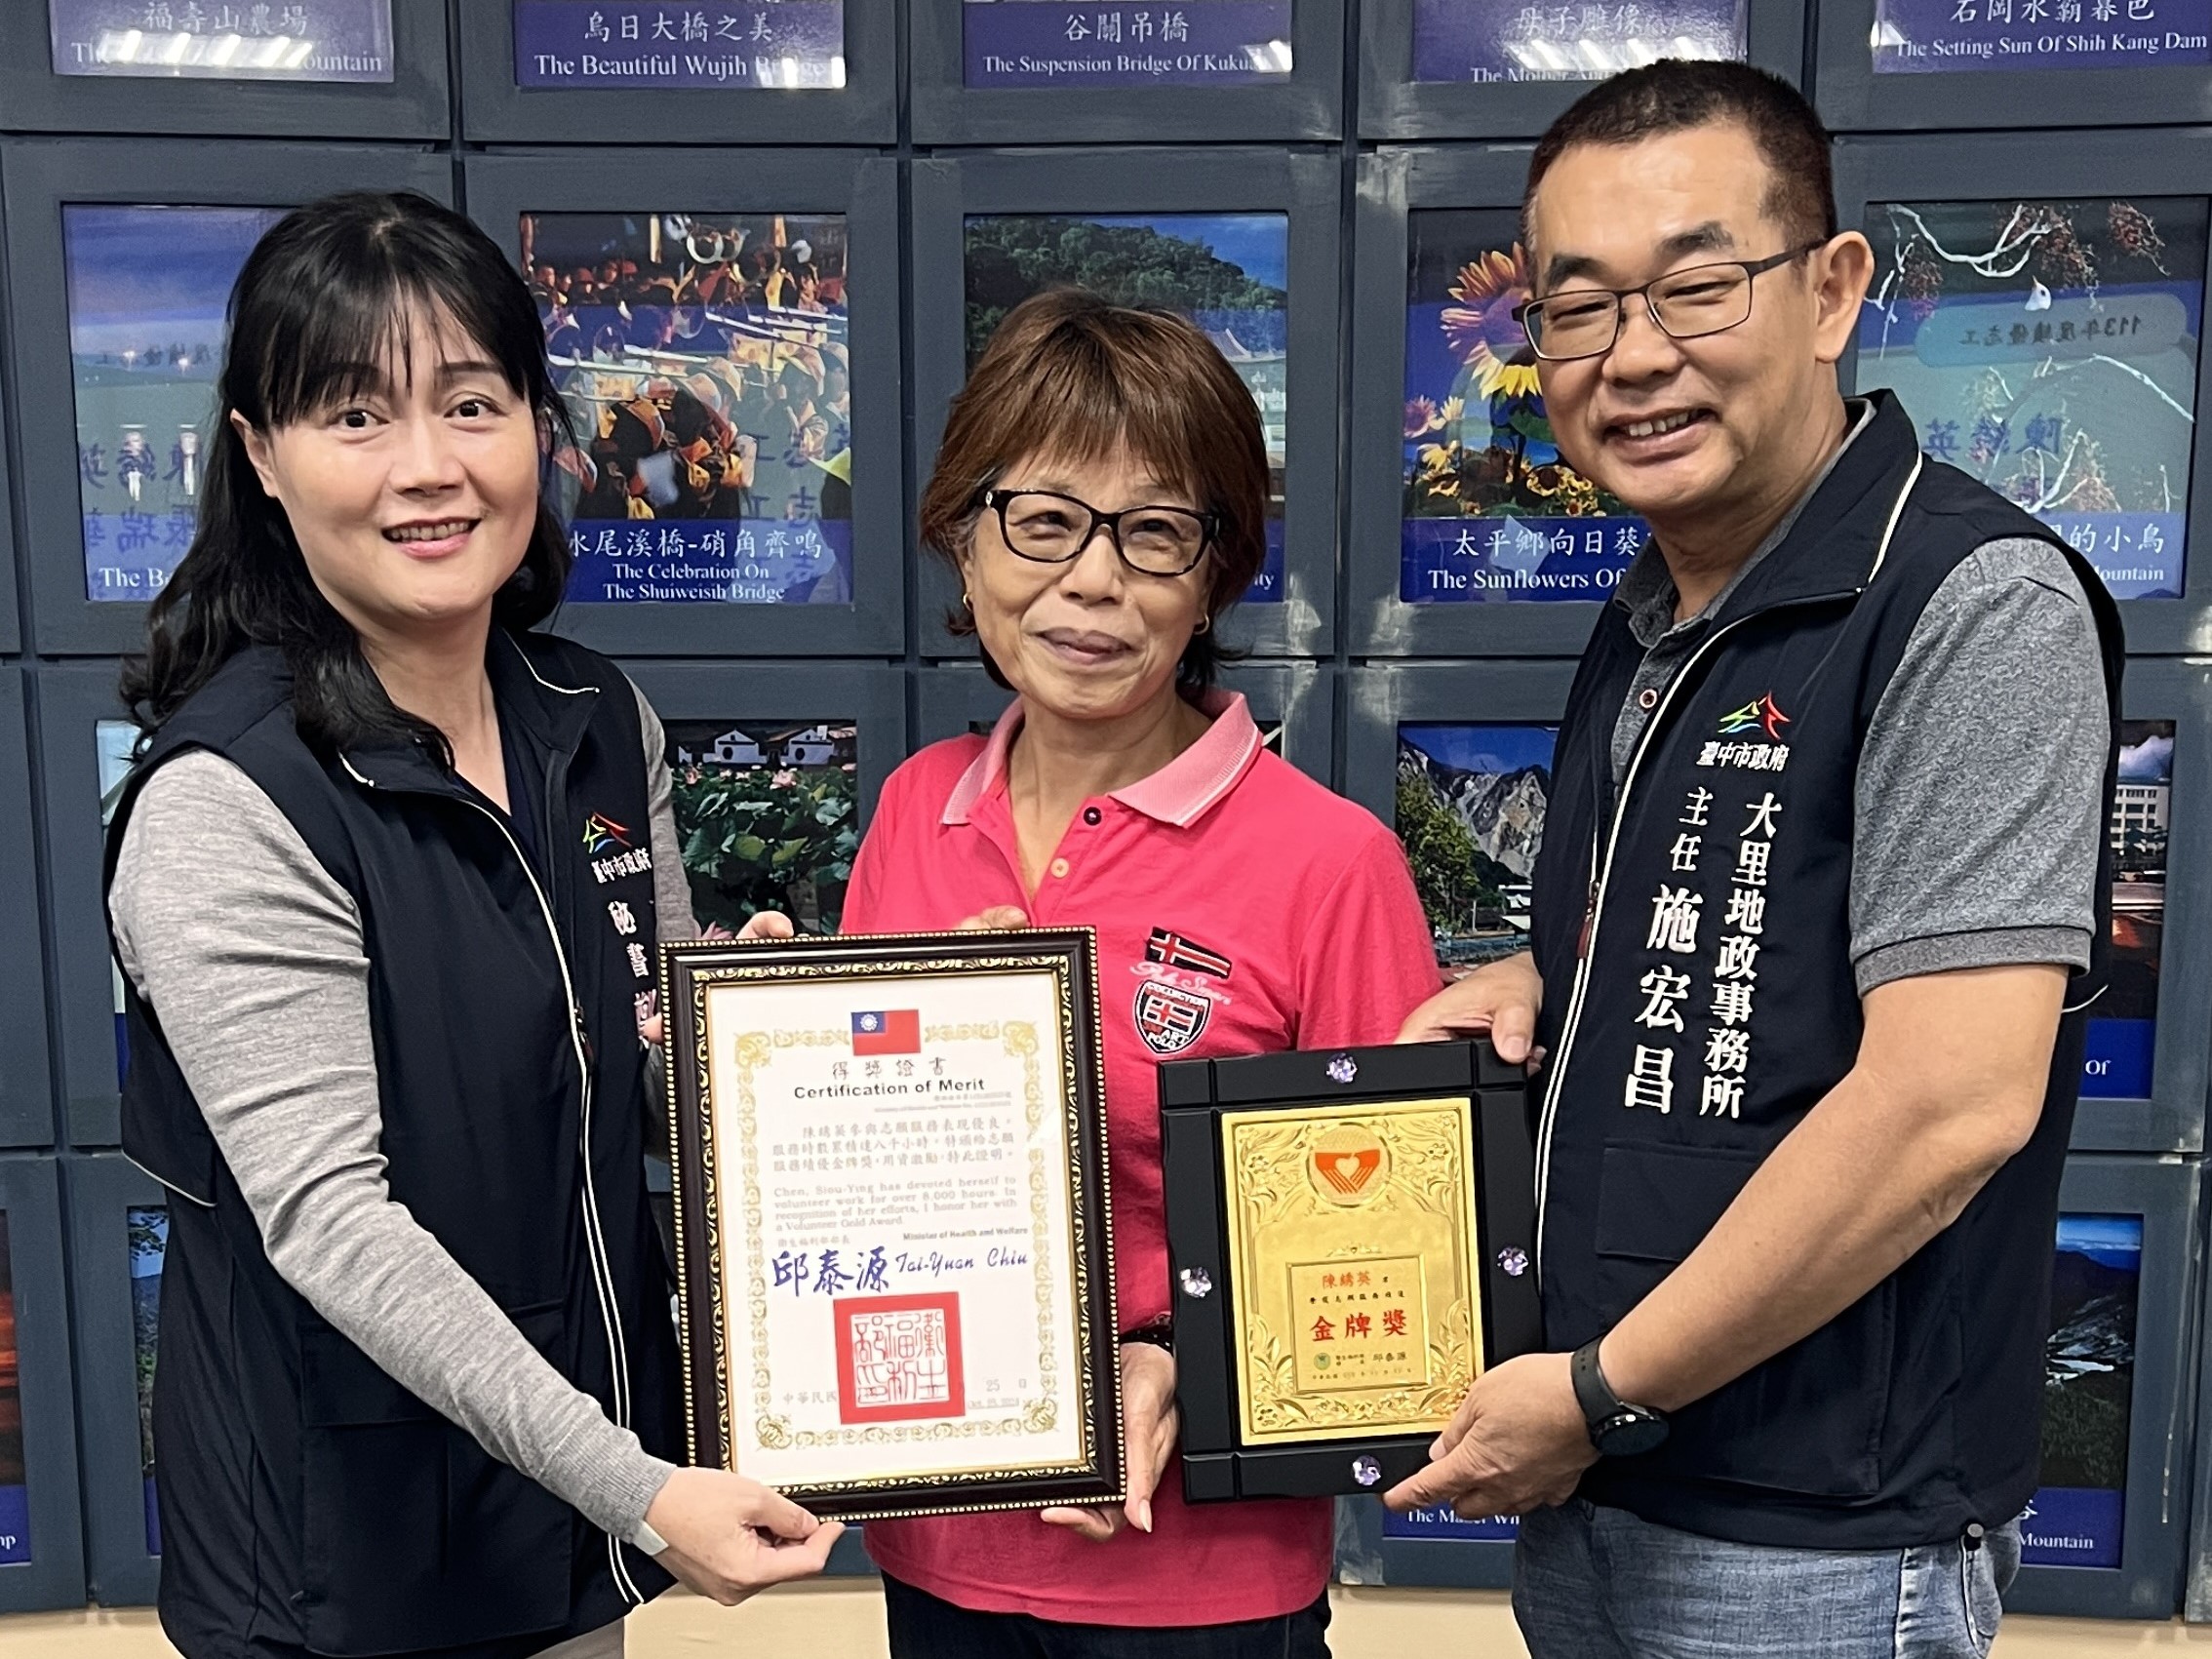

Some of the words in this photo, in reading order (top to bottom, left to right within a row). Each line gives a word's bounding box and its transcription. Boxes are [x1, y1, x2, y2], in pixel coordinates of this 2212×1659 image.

[585, 11, 773, 43] 烏日大橋之美
[1064, 12, 1189, 43] 谷關吊橋
[1898, 40, 1927, 57] The
[1932, 38, 1994, 59] Setting
[1998, 36, 2033, 54] Sun
[2037, 35, 2063, 54] Of
[2066, 34, 2107, 53] Shih
[2112, 33, 2159, 55] Kang
[2164, 32, 2208, 50] Dam
[298, 50, 382, 72] ountain
[534, 56, 575, 77] The
[582, 55, 677, 77] Beautiful
[685, 56, 747, 81] Wujih
[983, 56, 1014, 73] The
[1019, 55, 1112, 76] Suspension
[1117, 55, 1172, 76] Bridge
[1176, 55, 1202, 72] Of
[1471, 67, 1503, 82] The
[1453, 527, 1651, 557] 太平鄉向日葵
[2051, 523, 2164, 554] 的小鳥
[99, 568, 141, 587] The
[612, 564, 644, 579] The
[649, 564, 740, 579] Celebration
[745, 564, 770, 579] On
[1428, 569, 1467, 589] The
[1474, 569, 1589, 589] Sunflowers
[1595, 569, 1627, 587] Of
[604, 584, 635, 600] The
[640, 584, 727, 600] Shuiweisih
[731, 584, 786, 604] Bridge
[1695, 740, 1791, 771] 臺中市政府
[1671, 786, 1715, 873] 主任
[1699, 791, 1783, 1120] 大里地政事務所
[1624, 883, 1704, 1115] 施宏昌
[2085, 1059, 2113, 1076] Of
[794, 1083, 909, 1099] Certification
[915, 1080, 933, 1093] of
[938, 1078, 986, 1093] Merit
[774, 1199, 831, 1209] volunteer
[836, 1196, 864, 1205] work
[871, 1194, 887, 1204] for
[892, 1194, 918, 1203] over
[858, 1206, 877, 1216] her
[970, 1201, 989, 1209] her
[986, 1246, 1028, 1267] Chiu
[772, 1245, 889, 1297] 邱泰源
[1309, 1308, 1409, 1342] 金牌獎
